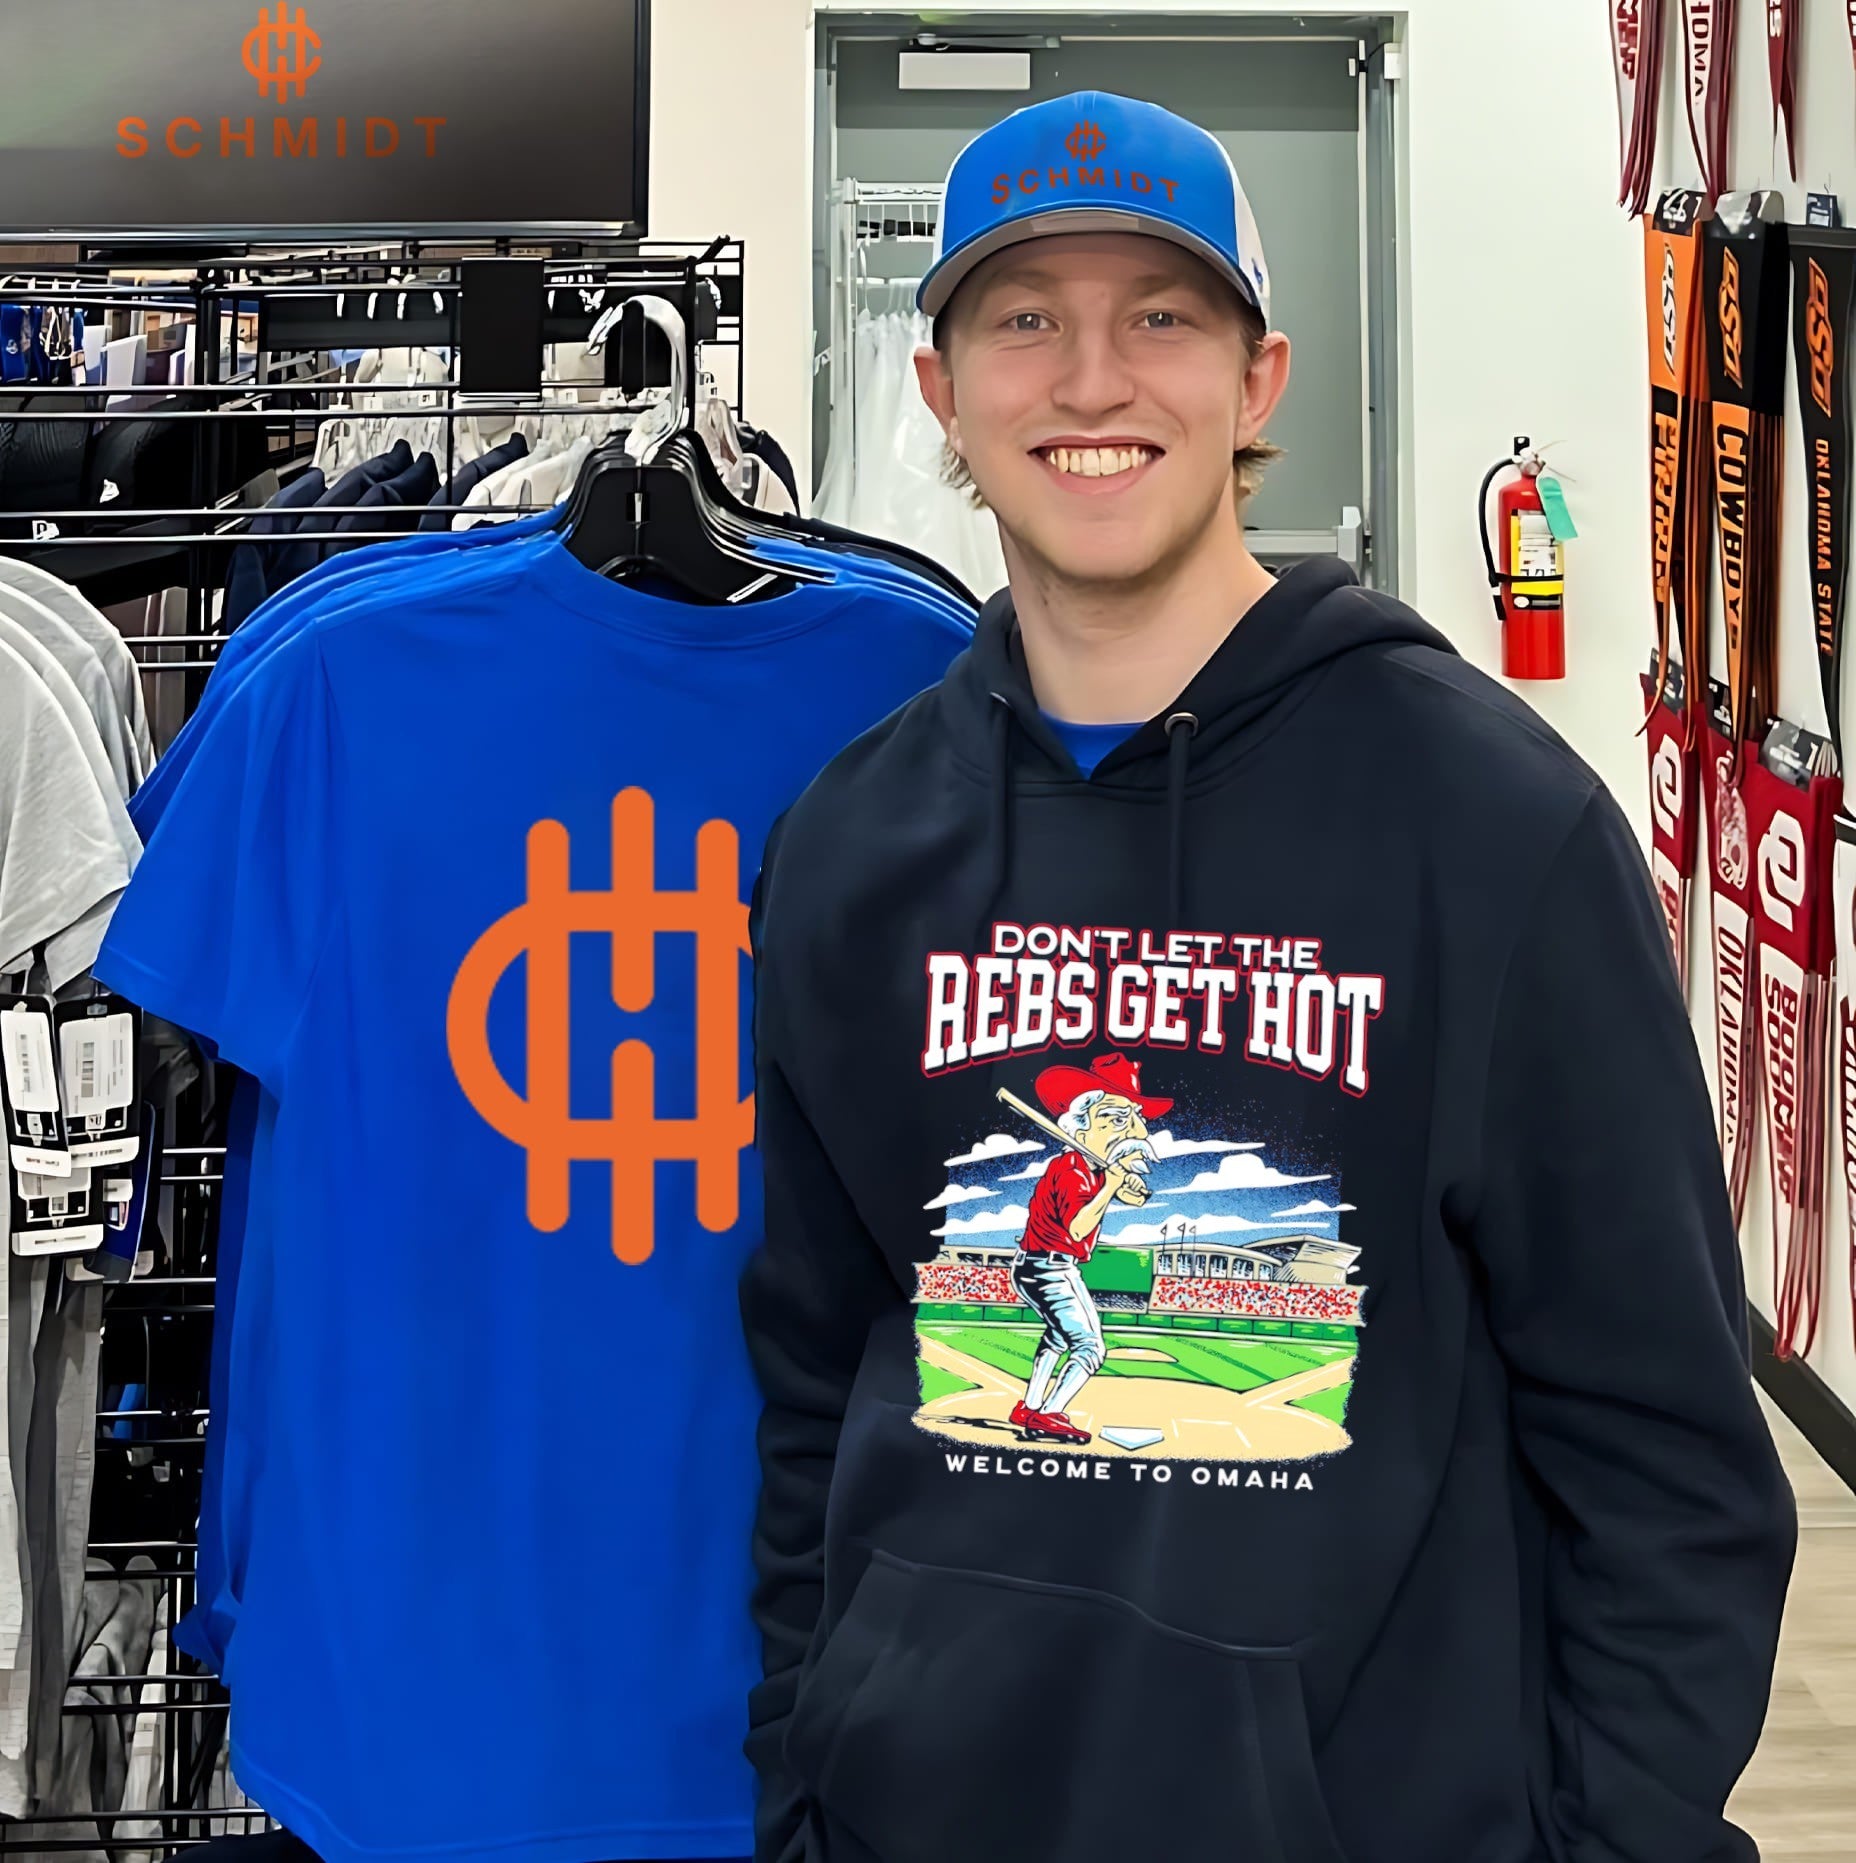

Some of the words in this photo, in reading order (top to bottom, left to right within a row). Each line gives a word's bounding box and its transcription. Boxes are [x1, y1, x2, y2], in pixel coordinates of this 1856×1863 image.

[115, 115, 448, 159] SCHMIDT
[990, 165, 1180, 204] SCHMIDT
[1815, 437, 1833, 571] OKLAHOMA
[993, 924, 1130, 960] DON'T
[1140, 931, 1224, 965] LET
[1233, 936, 1320, 971] THE
[923, 954, 1096, 1070] REBS
[1106, 961, 1237, 1048] GET
[1248, 970, 1382, 1091] HOT
[945, 1453, 1112, 1481] WELCOME
[1130, 1463, 1172, 1483] TO
[1191, 1466, 1314, 1490] OMAHA
